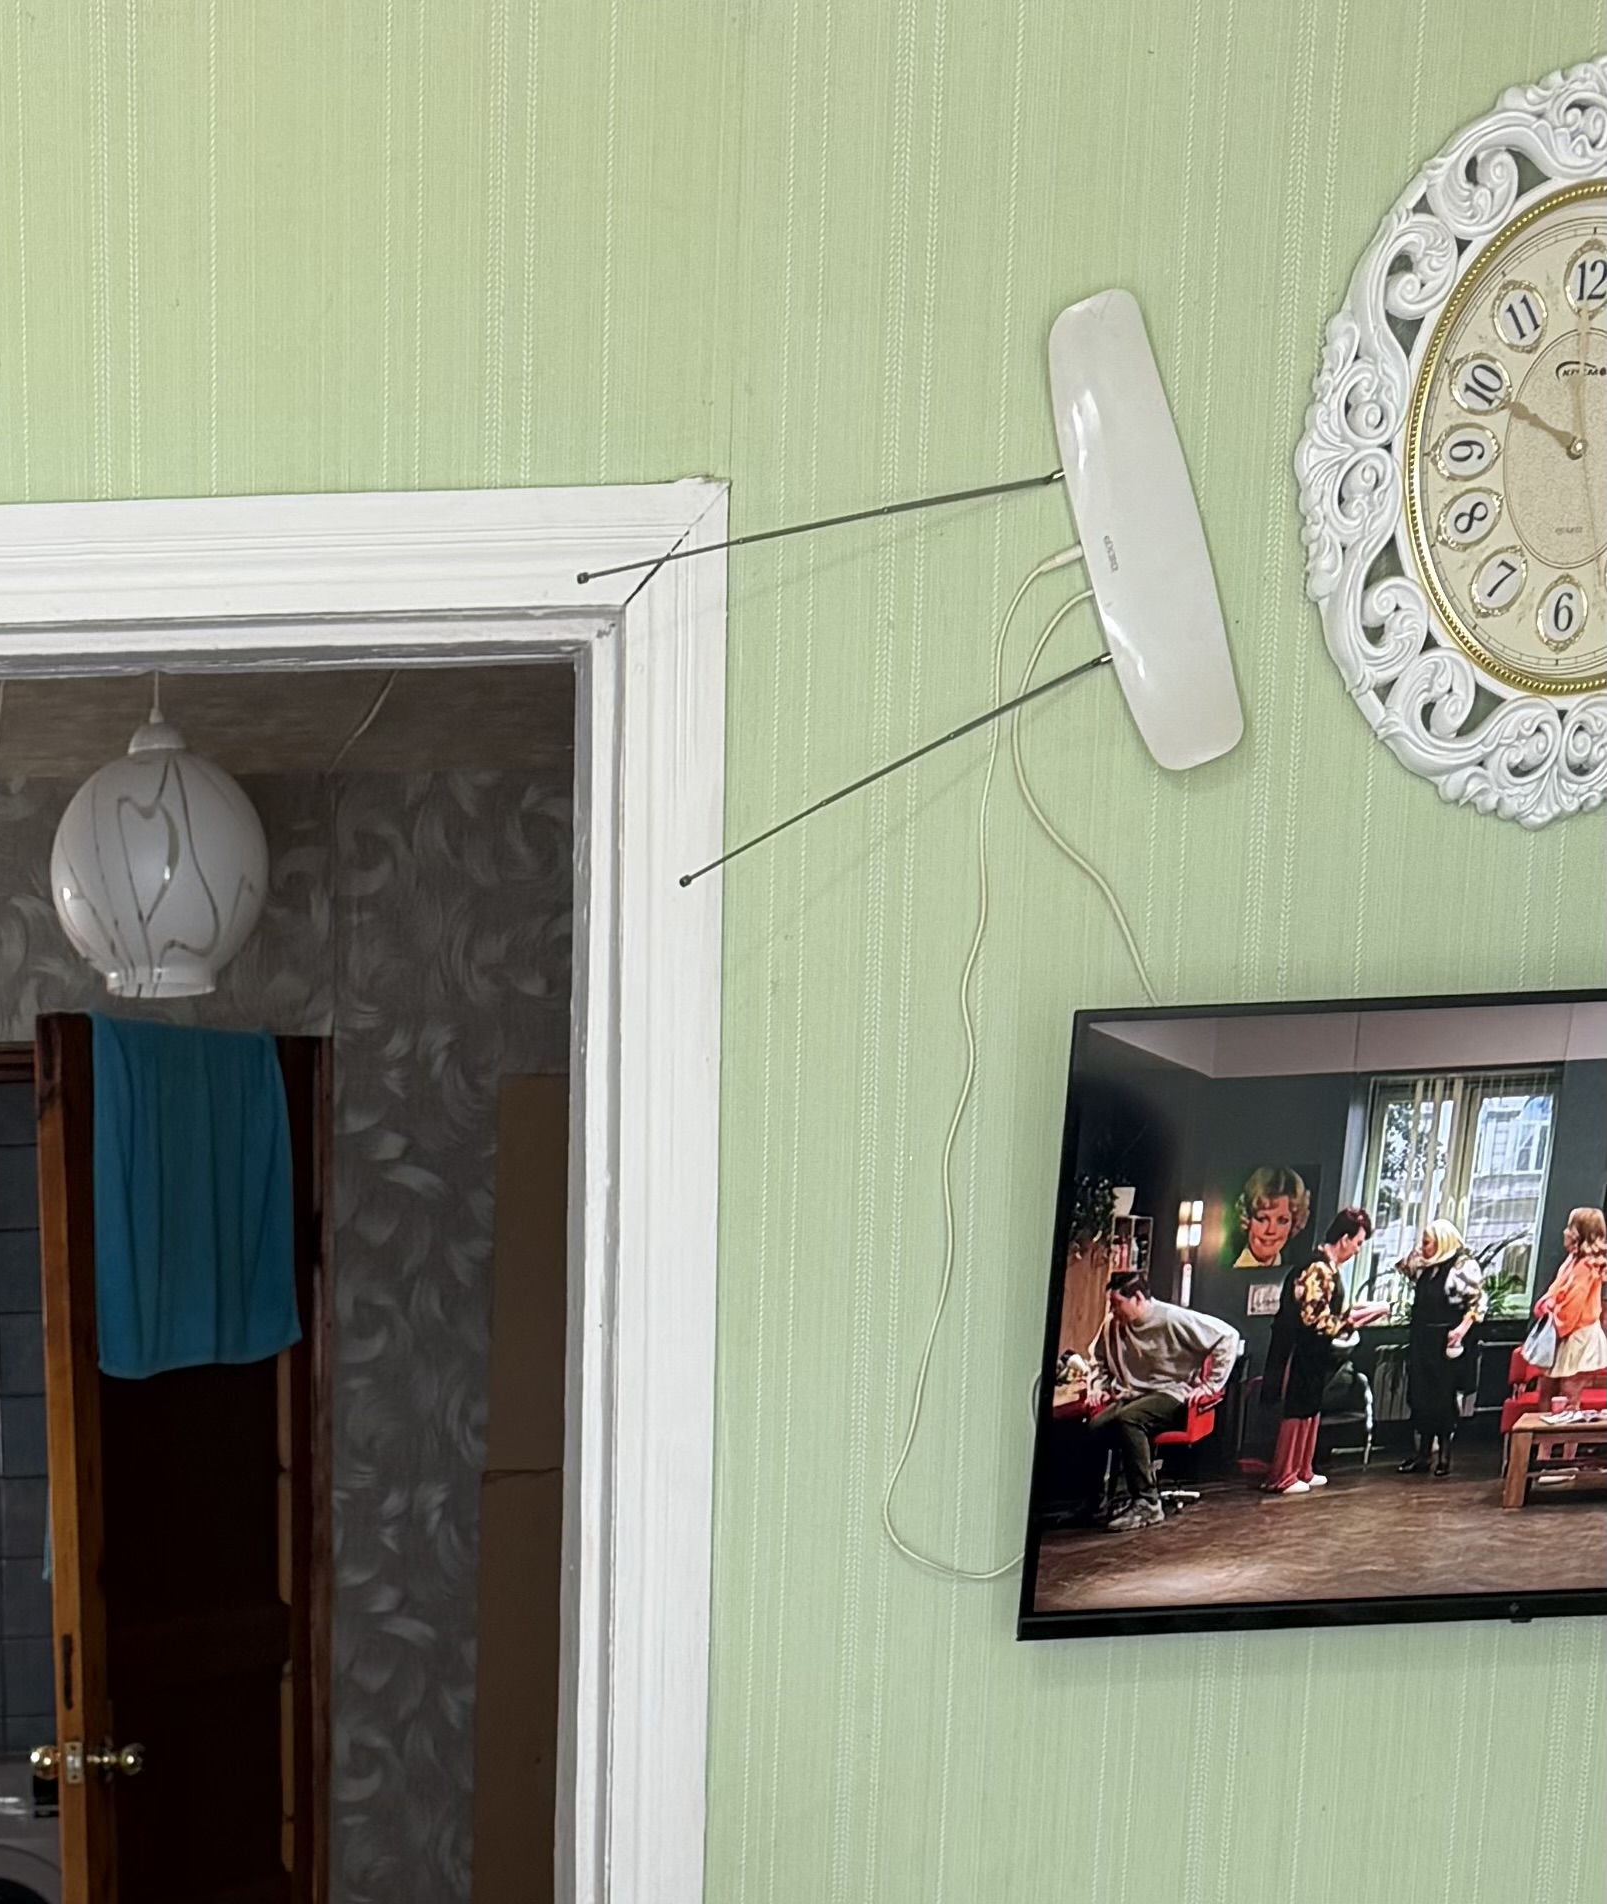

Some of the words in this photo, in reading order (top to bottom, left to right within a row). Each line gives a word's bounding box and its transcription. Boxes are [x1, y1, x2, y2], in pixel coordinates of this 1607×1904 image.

[1576, 258, 1607, 302] 12
[1505, 293, 1541, 341] 11
[1463, 363, 1504, 407] 10
[1448, 439, 1486, 463] 9
[1453, 500, 1489, 534] 8
[1486, 559, 1518, 598] 7
[1552, 591, 1575, 632] 6
